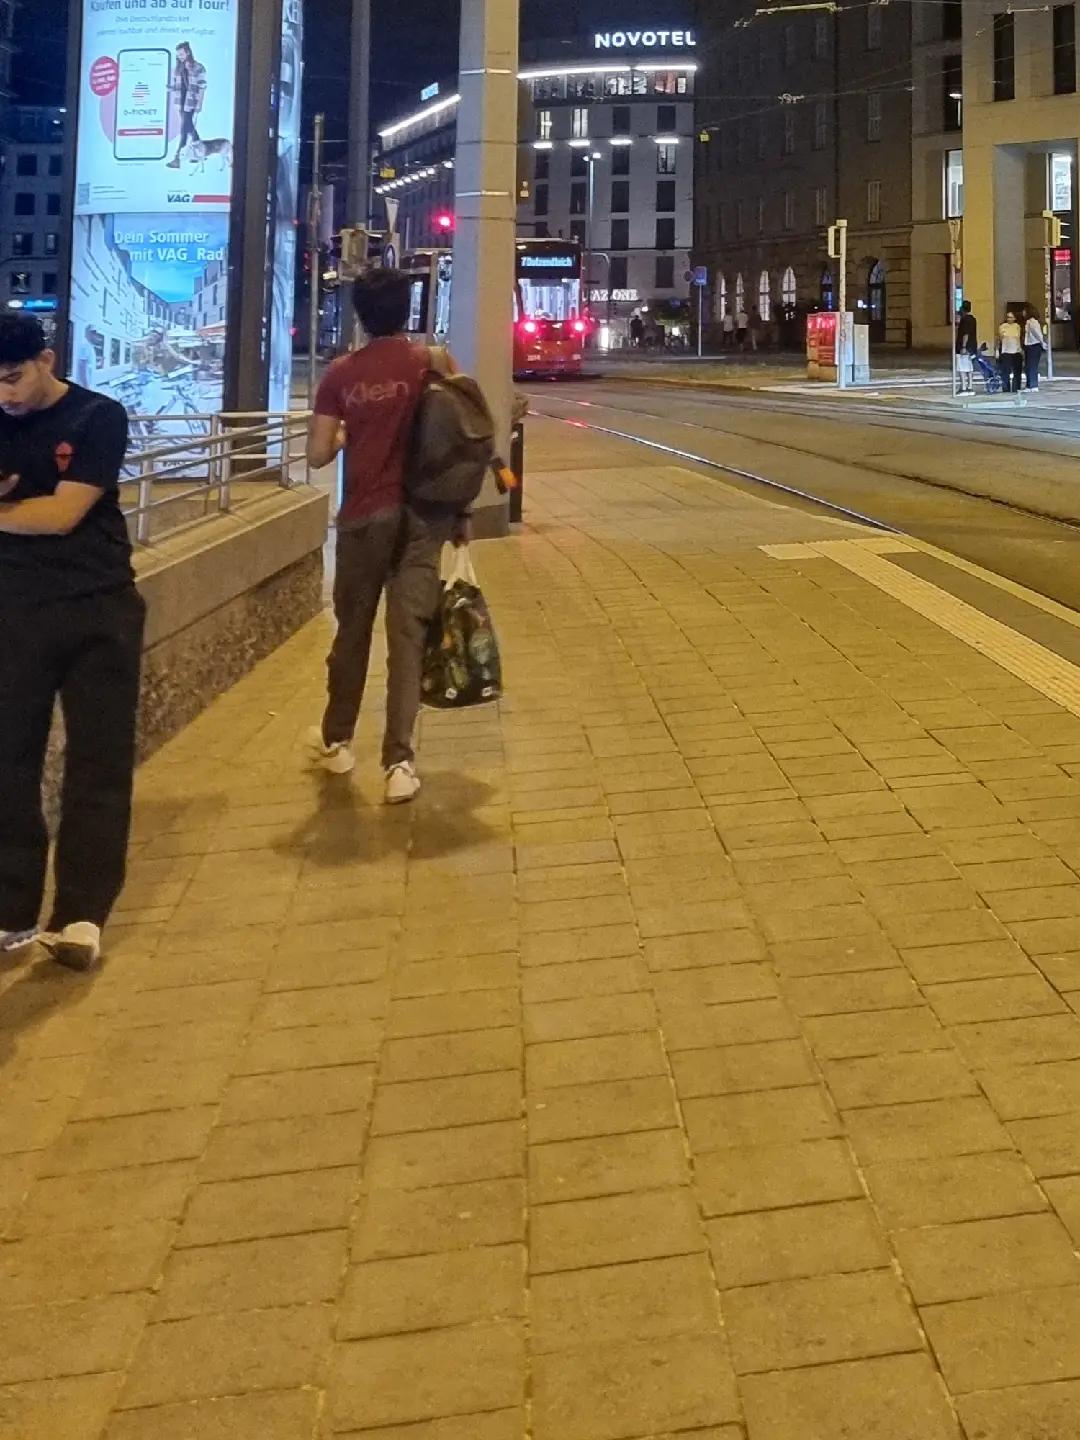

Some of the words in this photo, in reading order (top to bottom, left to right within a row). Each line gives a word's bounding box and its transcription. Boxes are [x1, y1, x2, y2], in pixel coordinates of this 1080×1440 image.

[594, 31, 697, 48] NOVOTEL
[167, 194, 191, 203] VAG
[114, 231, 144, 244] Dein
[150, 231, 209, 243] Sommer
[130, 248, 155, 261] mit
